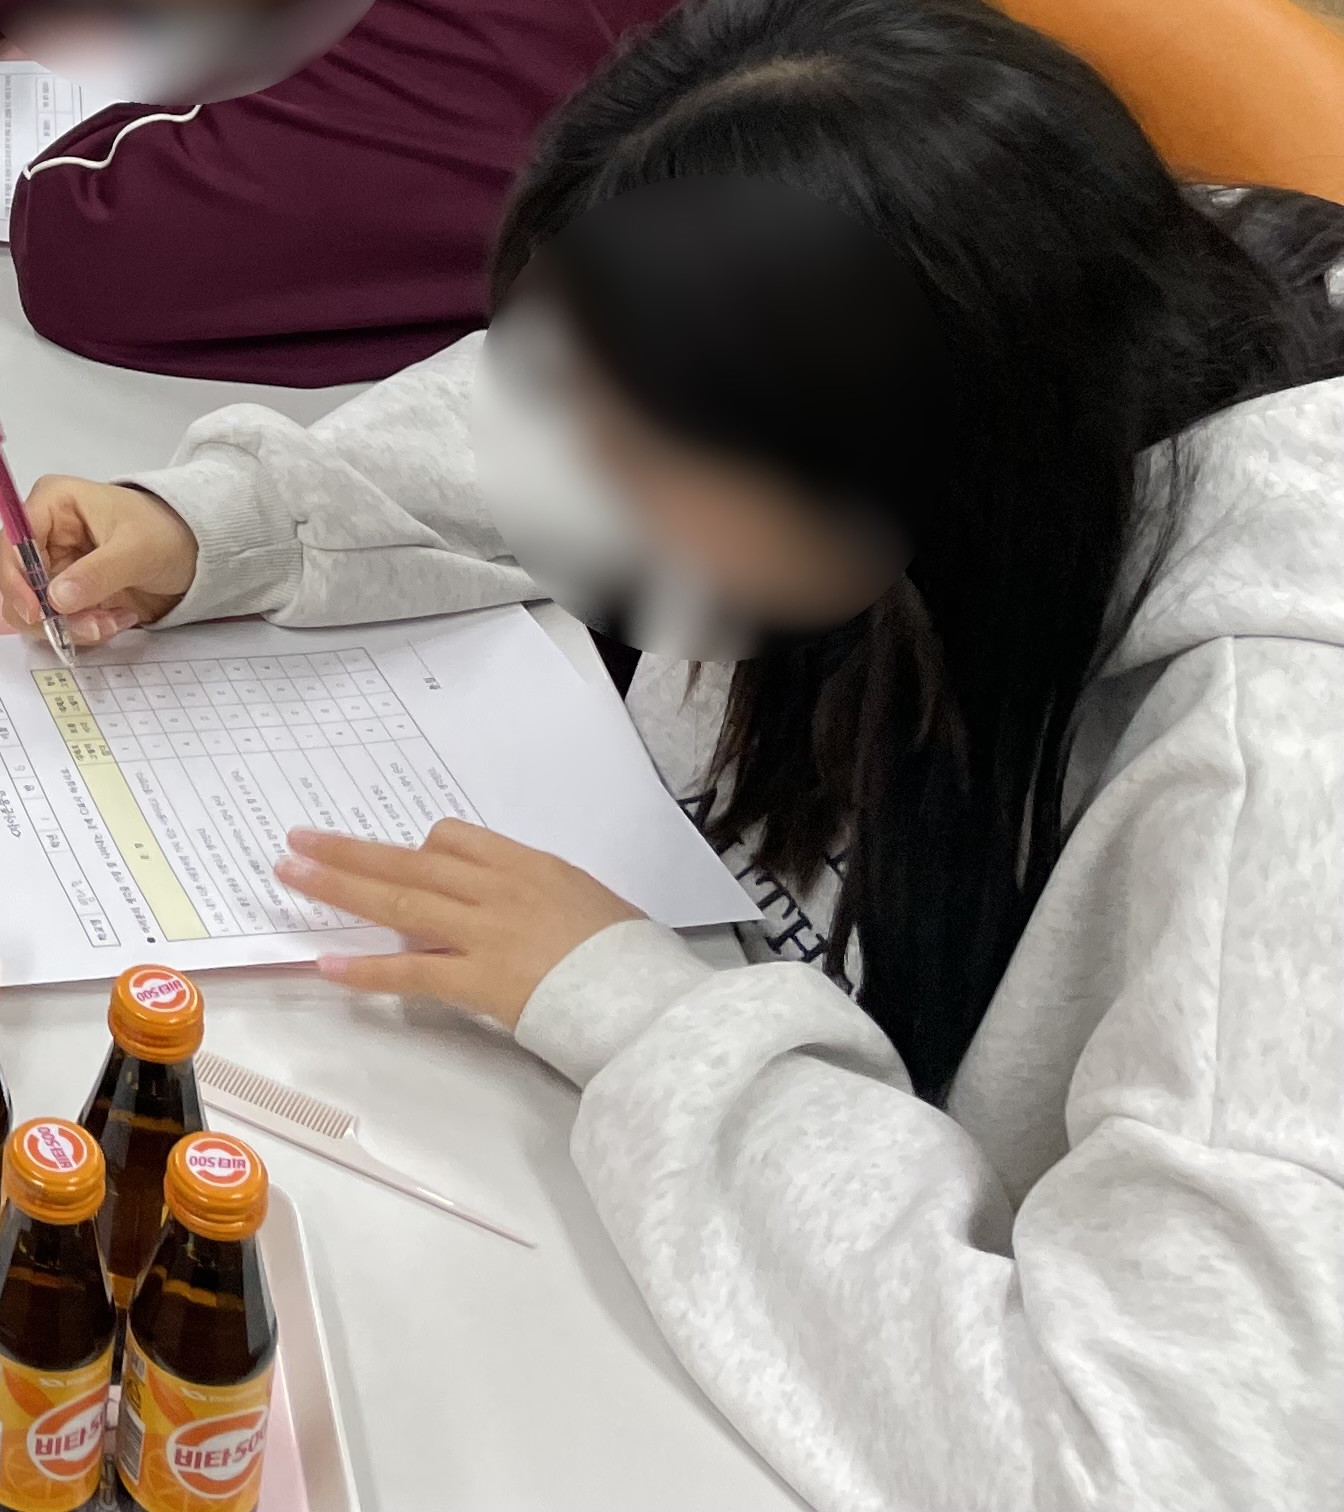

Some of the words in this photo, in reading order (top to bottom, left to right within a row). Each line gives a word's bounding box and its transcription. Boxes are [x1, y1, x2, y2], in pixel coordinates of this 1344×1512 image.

[136, 978, 183, 1003] 비타500
[37, 1125, 75, 1170] 비타500
[189, 1154, 247, 1170] 비타500
